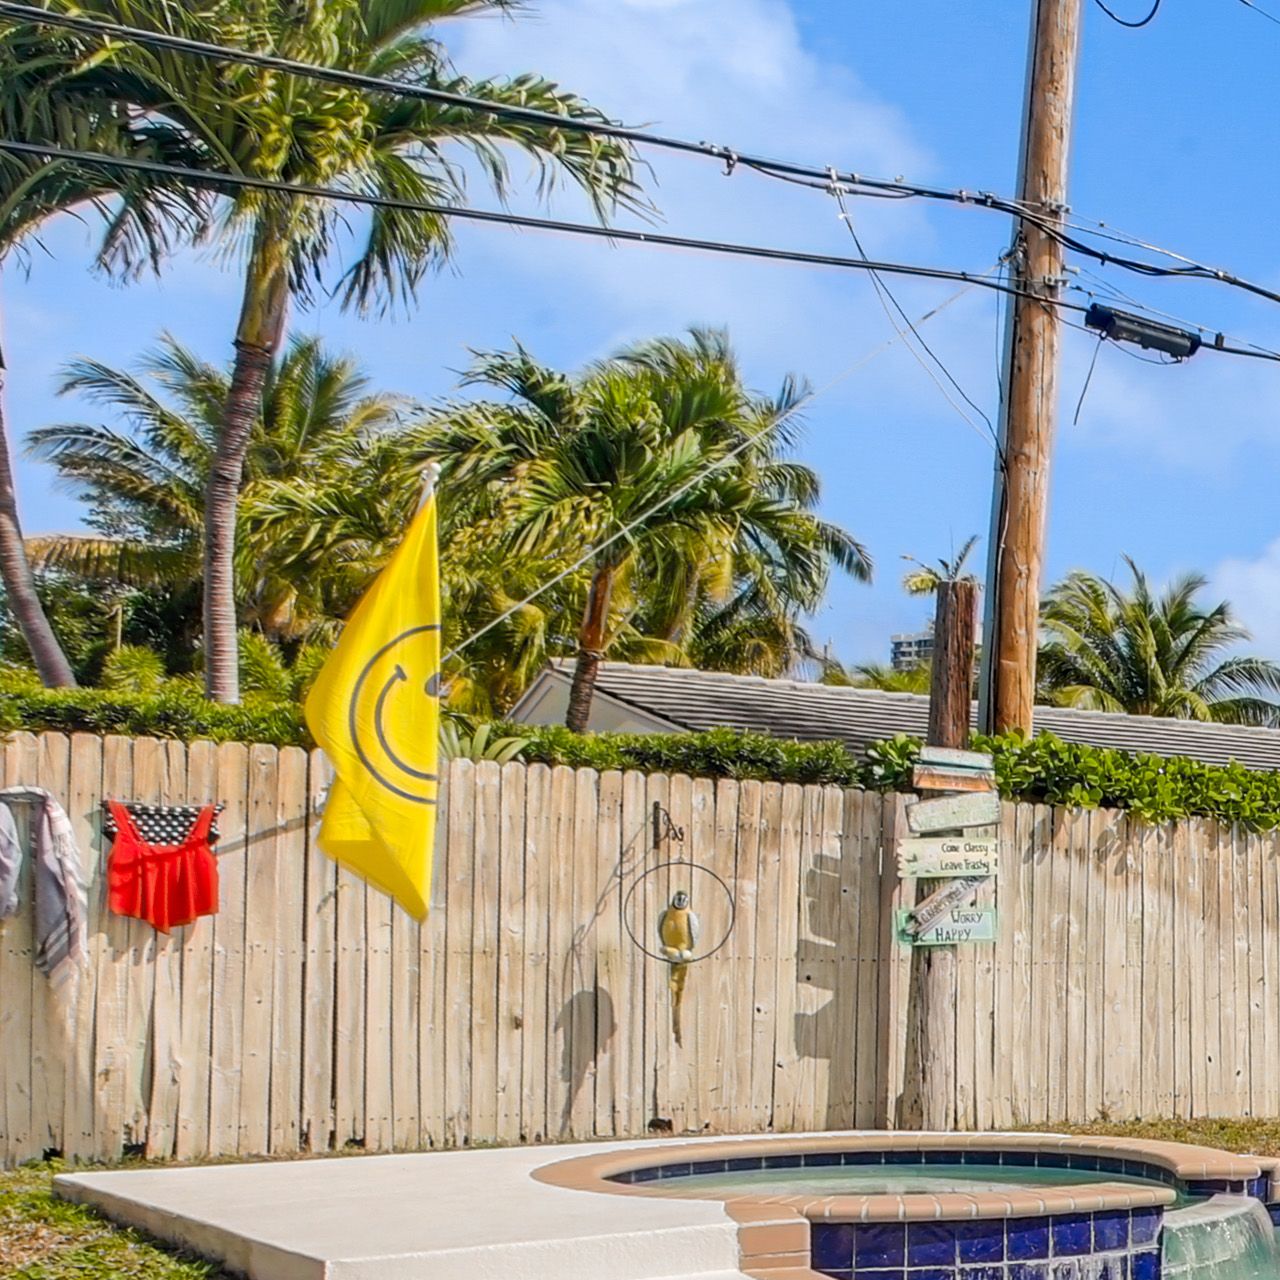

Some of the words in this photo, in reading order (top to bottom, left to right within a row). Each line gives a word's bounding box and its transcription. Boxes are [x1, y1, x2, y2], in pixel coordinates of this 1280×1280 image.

[941, 843, 960, 853] Come
[963, 842, 988, 856] Classy
[940, 860, 963, 870] Leave
[964, 858, 990, 873] Trashy
[951, 909, 983, 924] WORRY
[935, 927, 971, 942] HAPPY
